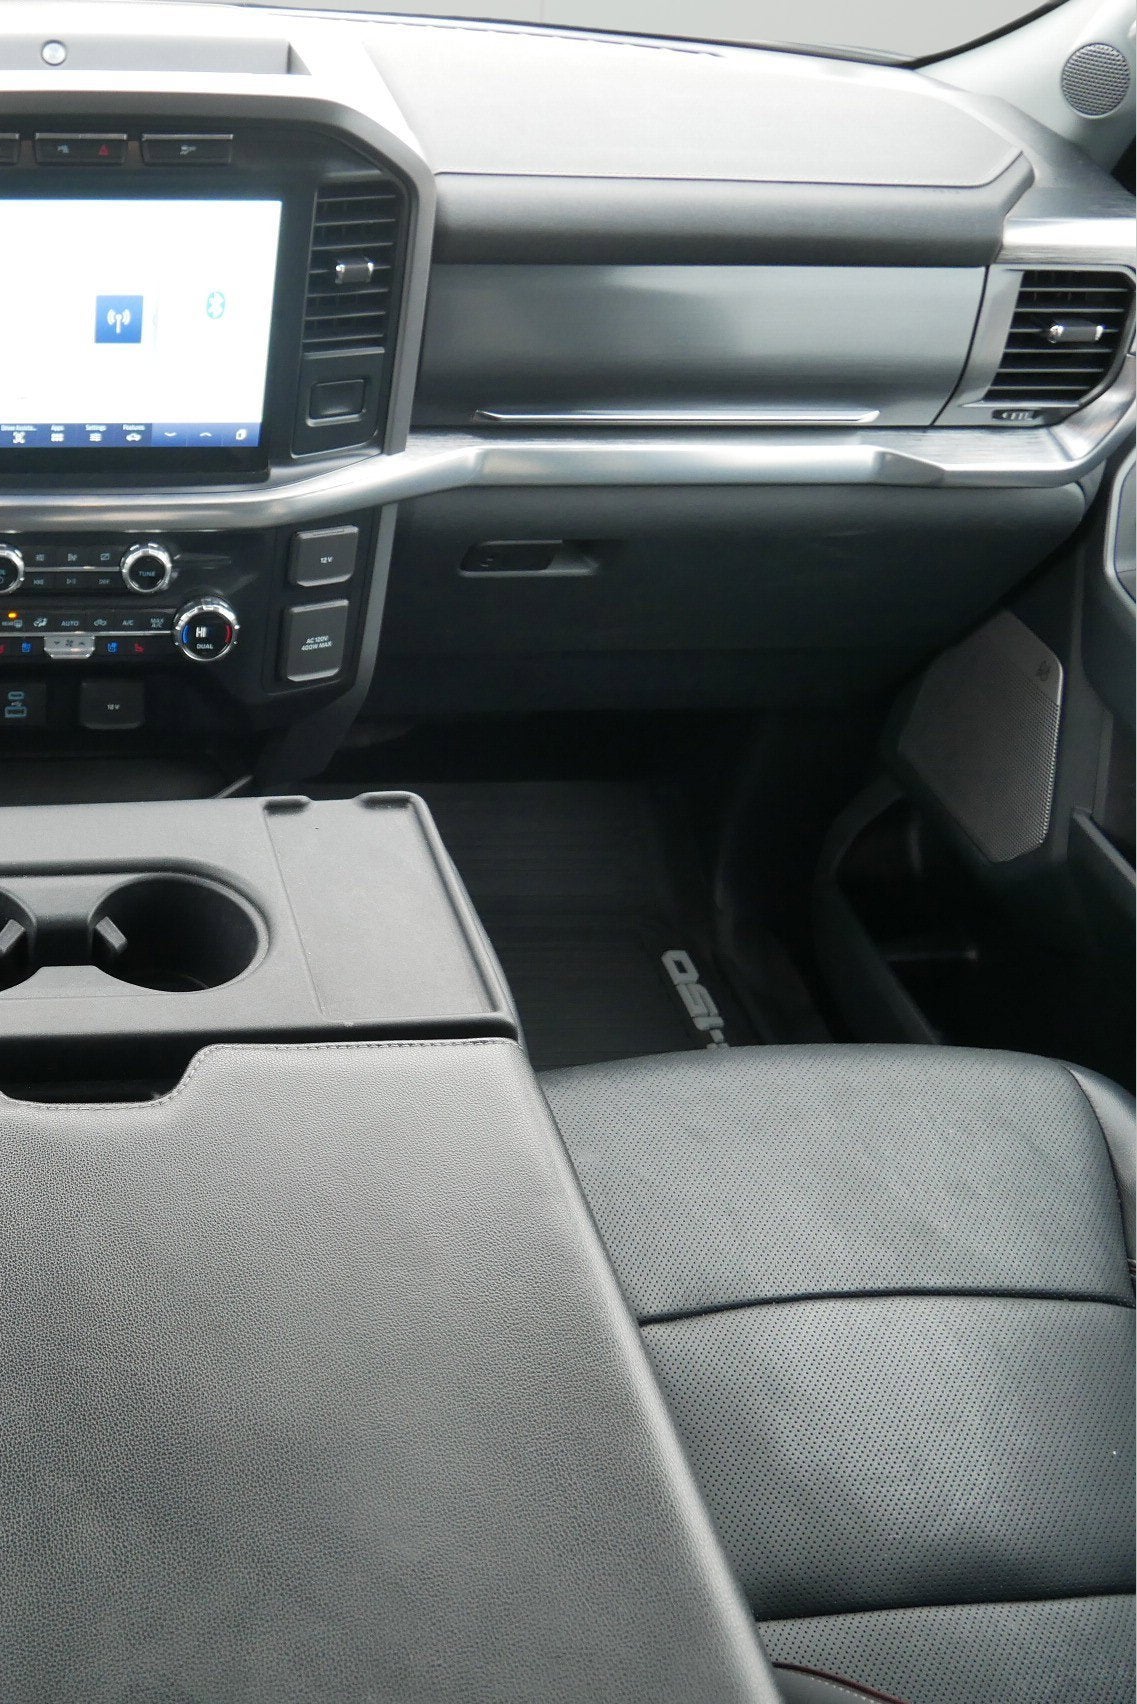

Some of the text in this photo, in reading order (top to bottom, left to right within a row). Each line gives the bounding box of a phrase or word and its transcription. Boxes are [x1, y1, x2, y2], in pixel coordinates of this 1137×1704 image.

[50, 424, 65, 432] Apps
[84, 424, 107, 432] Settings
[122, 424, 145, 432] Features
[60, 619, 80, 627] AUTO
[195, 626, 207, 638] HI
[196, 642, 213, 650] DUAL
[319, 641, 333, 649] MAX
